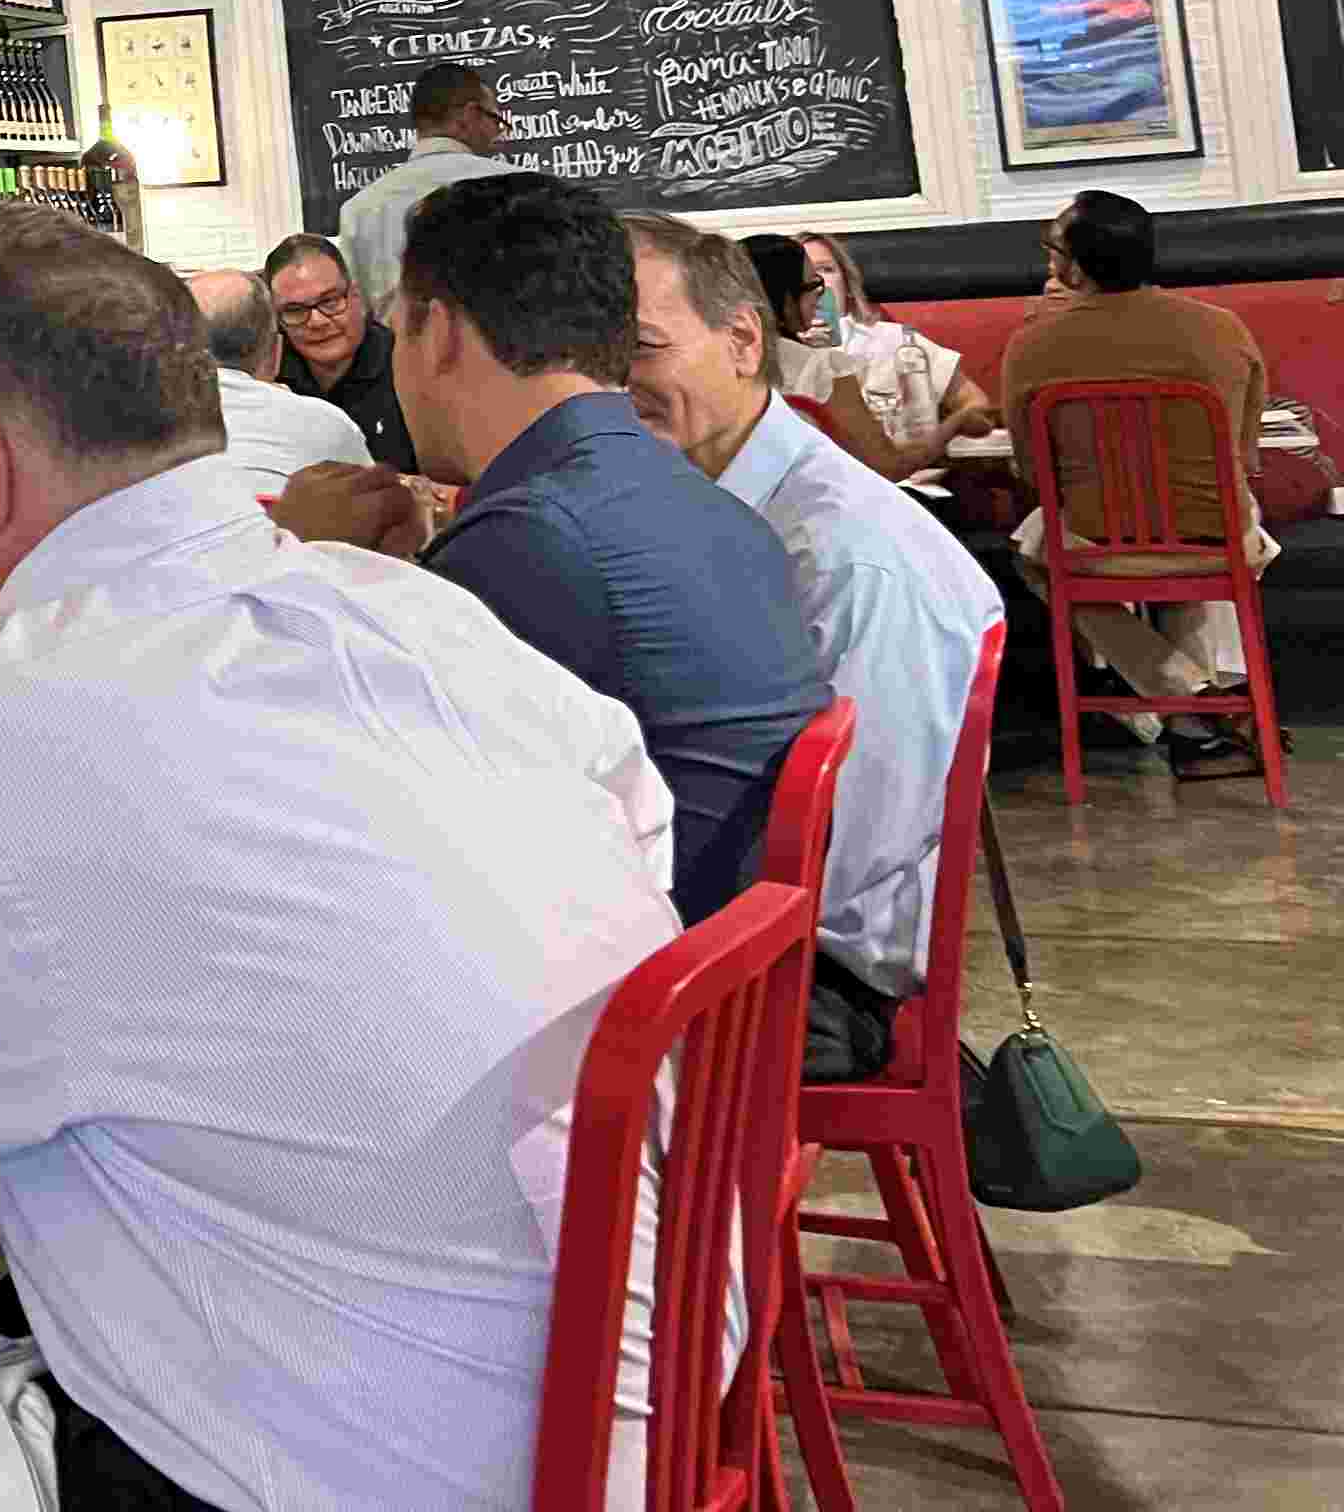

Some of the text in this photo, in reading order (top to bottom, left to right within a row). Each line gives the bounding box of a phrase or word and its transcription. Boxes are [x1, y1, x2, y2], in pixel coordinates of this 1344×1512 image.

[386, 23, 537, 57] CERVEZAS
[330, 81, 416, 119] TANGERIN
[496, 70, 560, 103] Great
